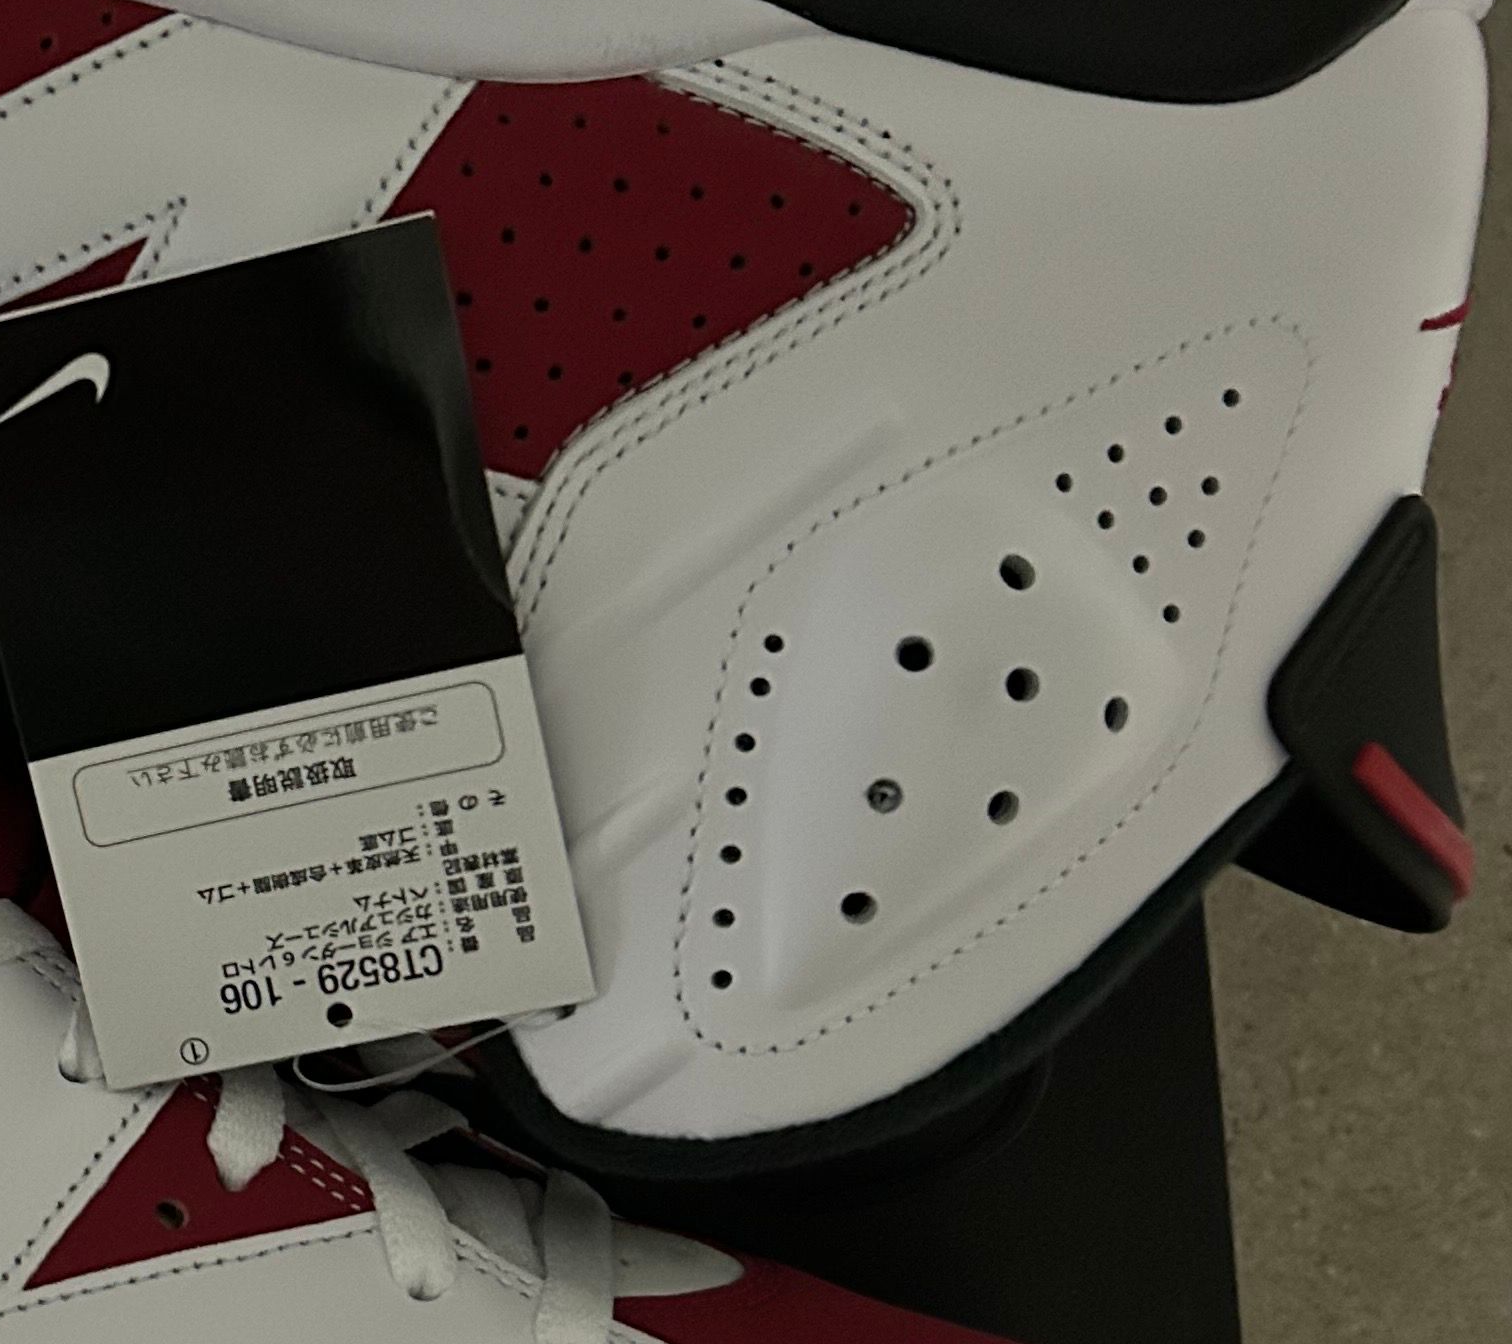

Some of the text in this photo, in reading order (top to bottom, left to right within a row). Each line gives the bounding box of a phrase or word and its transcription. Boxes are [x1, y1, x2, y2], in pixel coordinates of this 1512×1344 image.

[226, 754, 358, 803] 取扱説明書
[315, 942, 444, 996] CT8529
[218, 974, 283, 1016] 106
